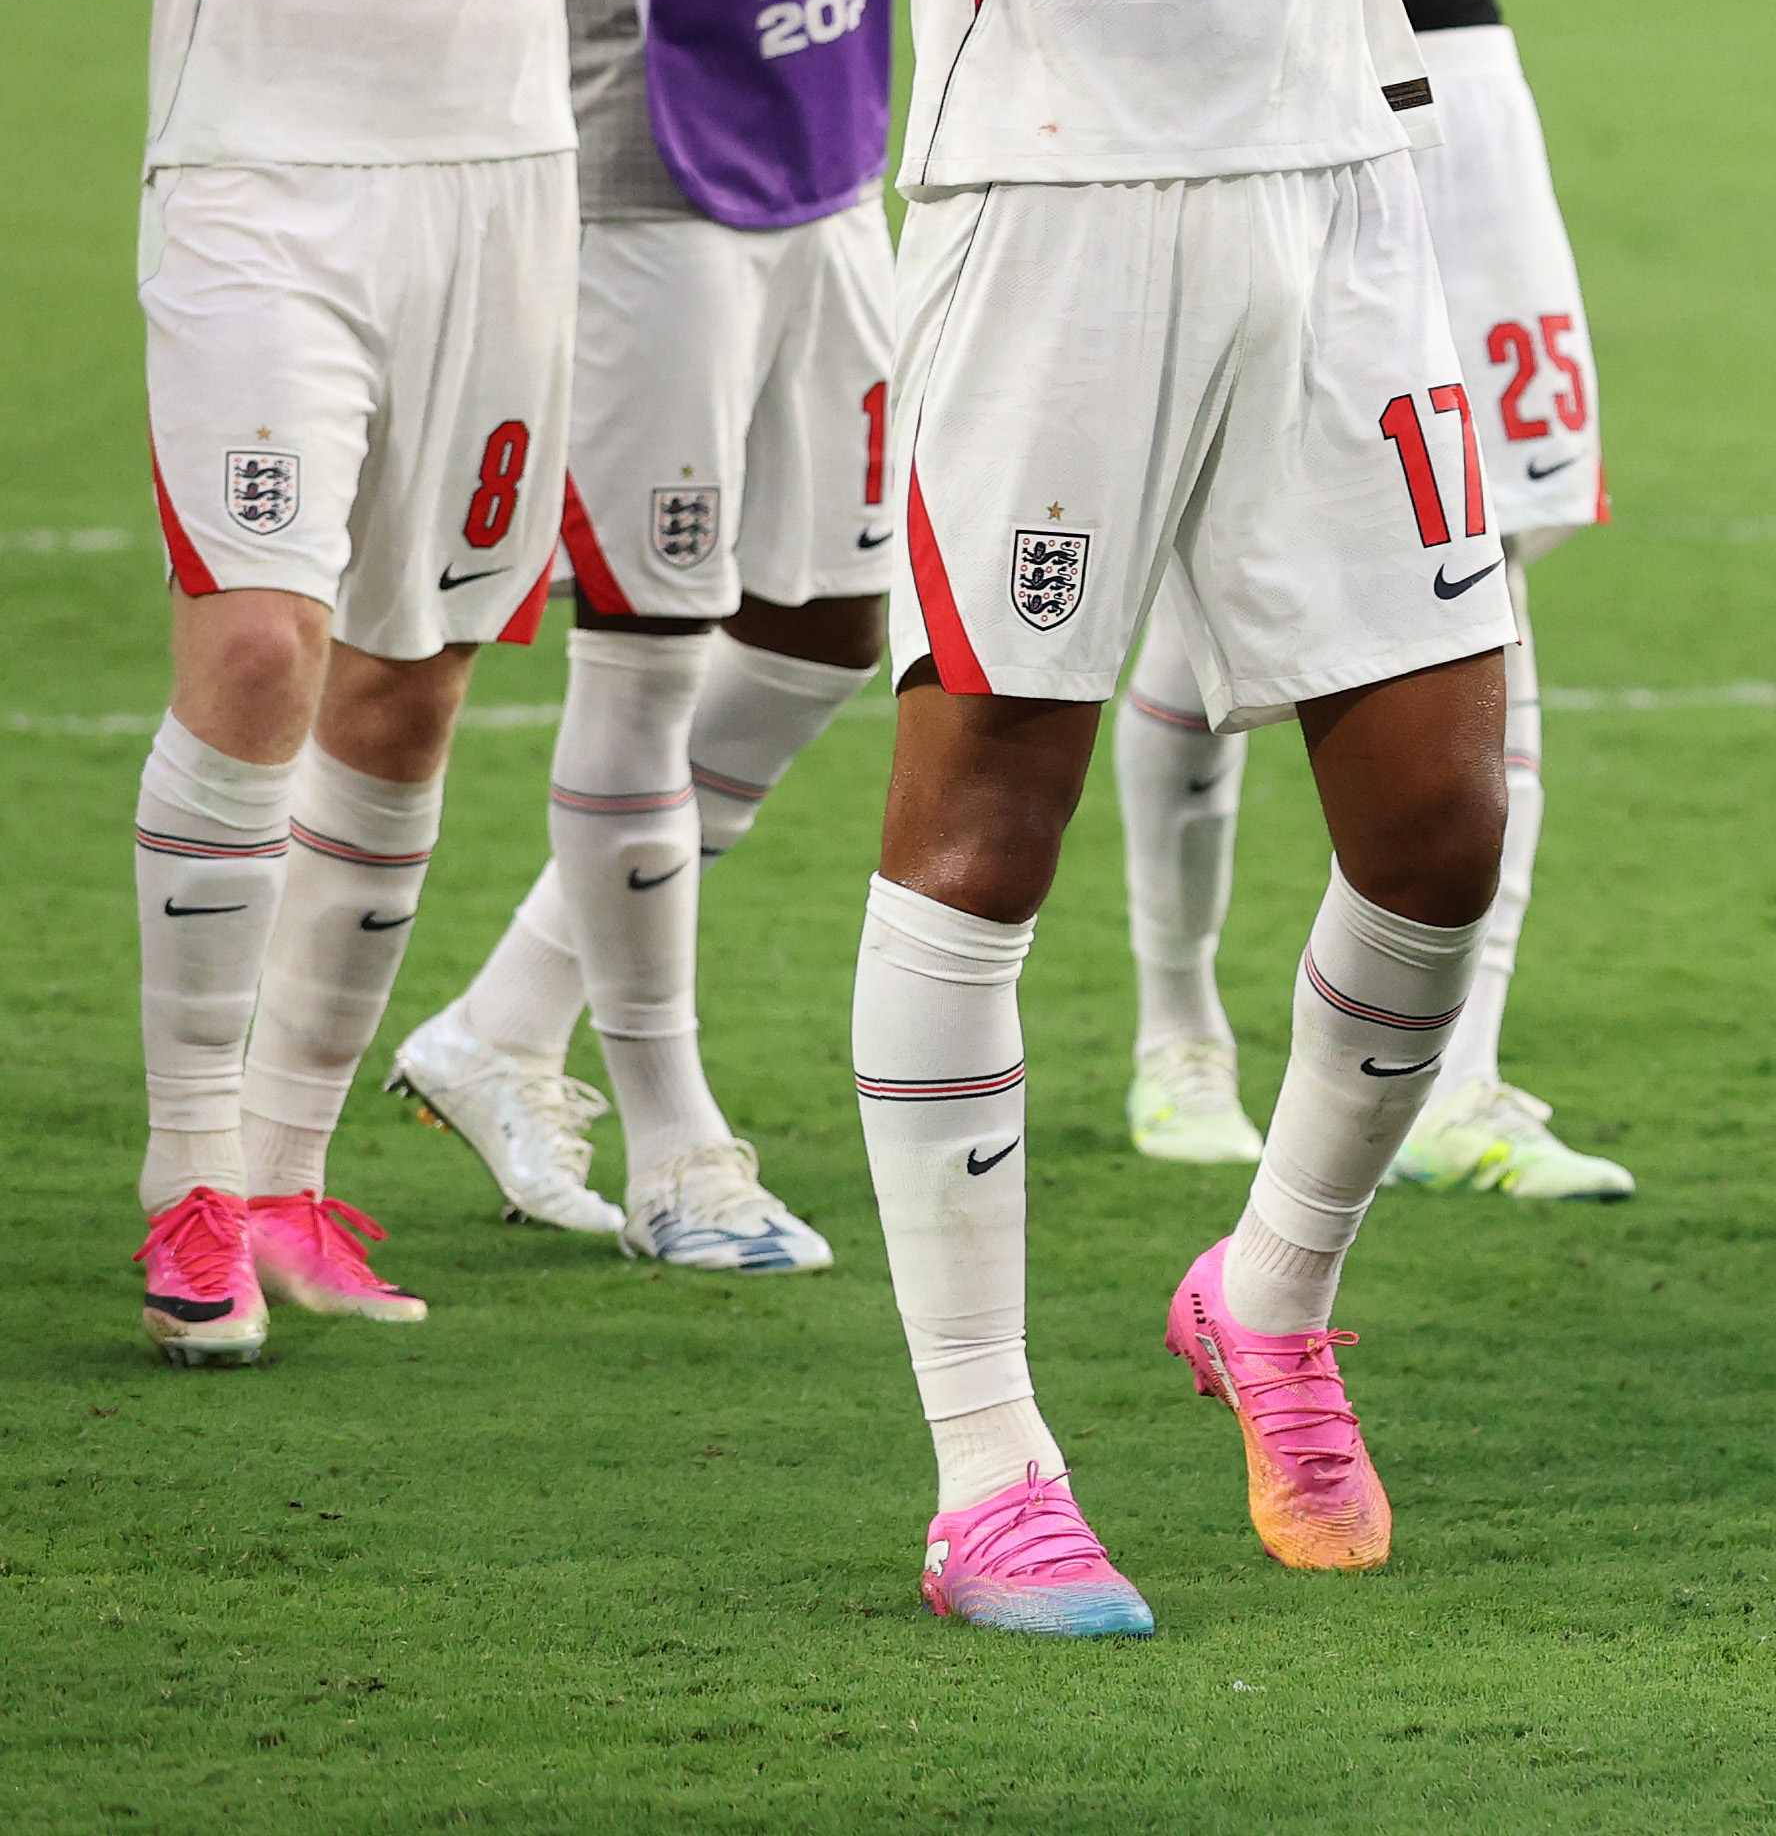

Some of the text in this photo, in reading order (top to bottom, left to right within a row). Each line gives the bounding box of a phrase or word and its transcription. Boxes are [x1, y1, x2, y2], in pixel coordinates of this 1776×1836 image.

[1486, 315, 1588, 442] 25
[464, 420, 529, 548] 8
[863, 381, 888, 506] 1
[1379, 383, 1487, 549] 17
